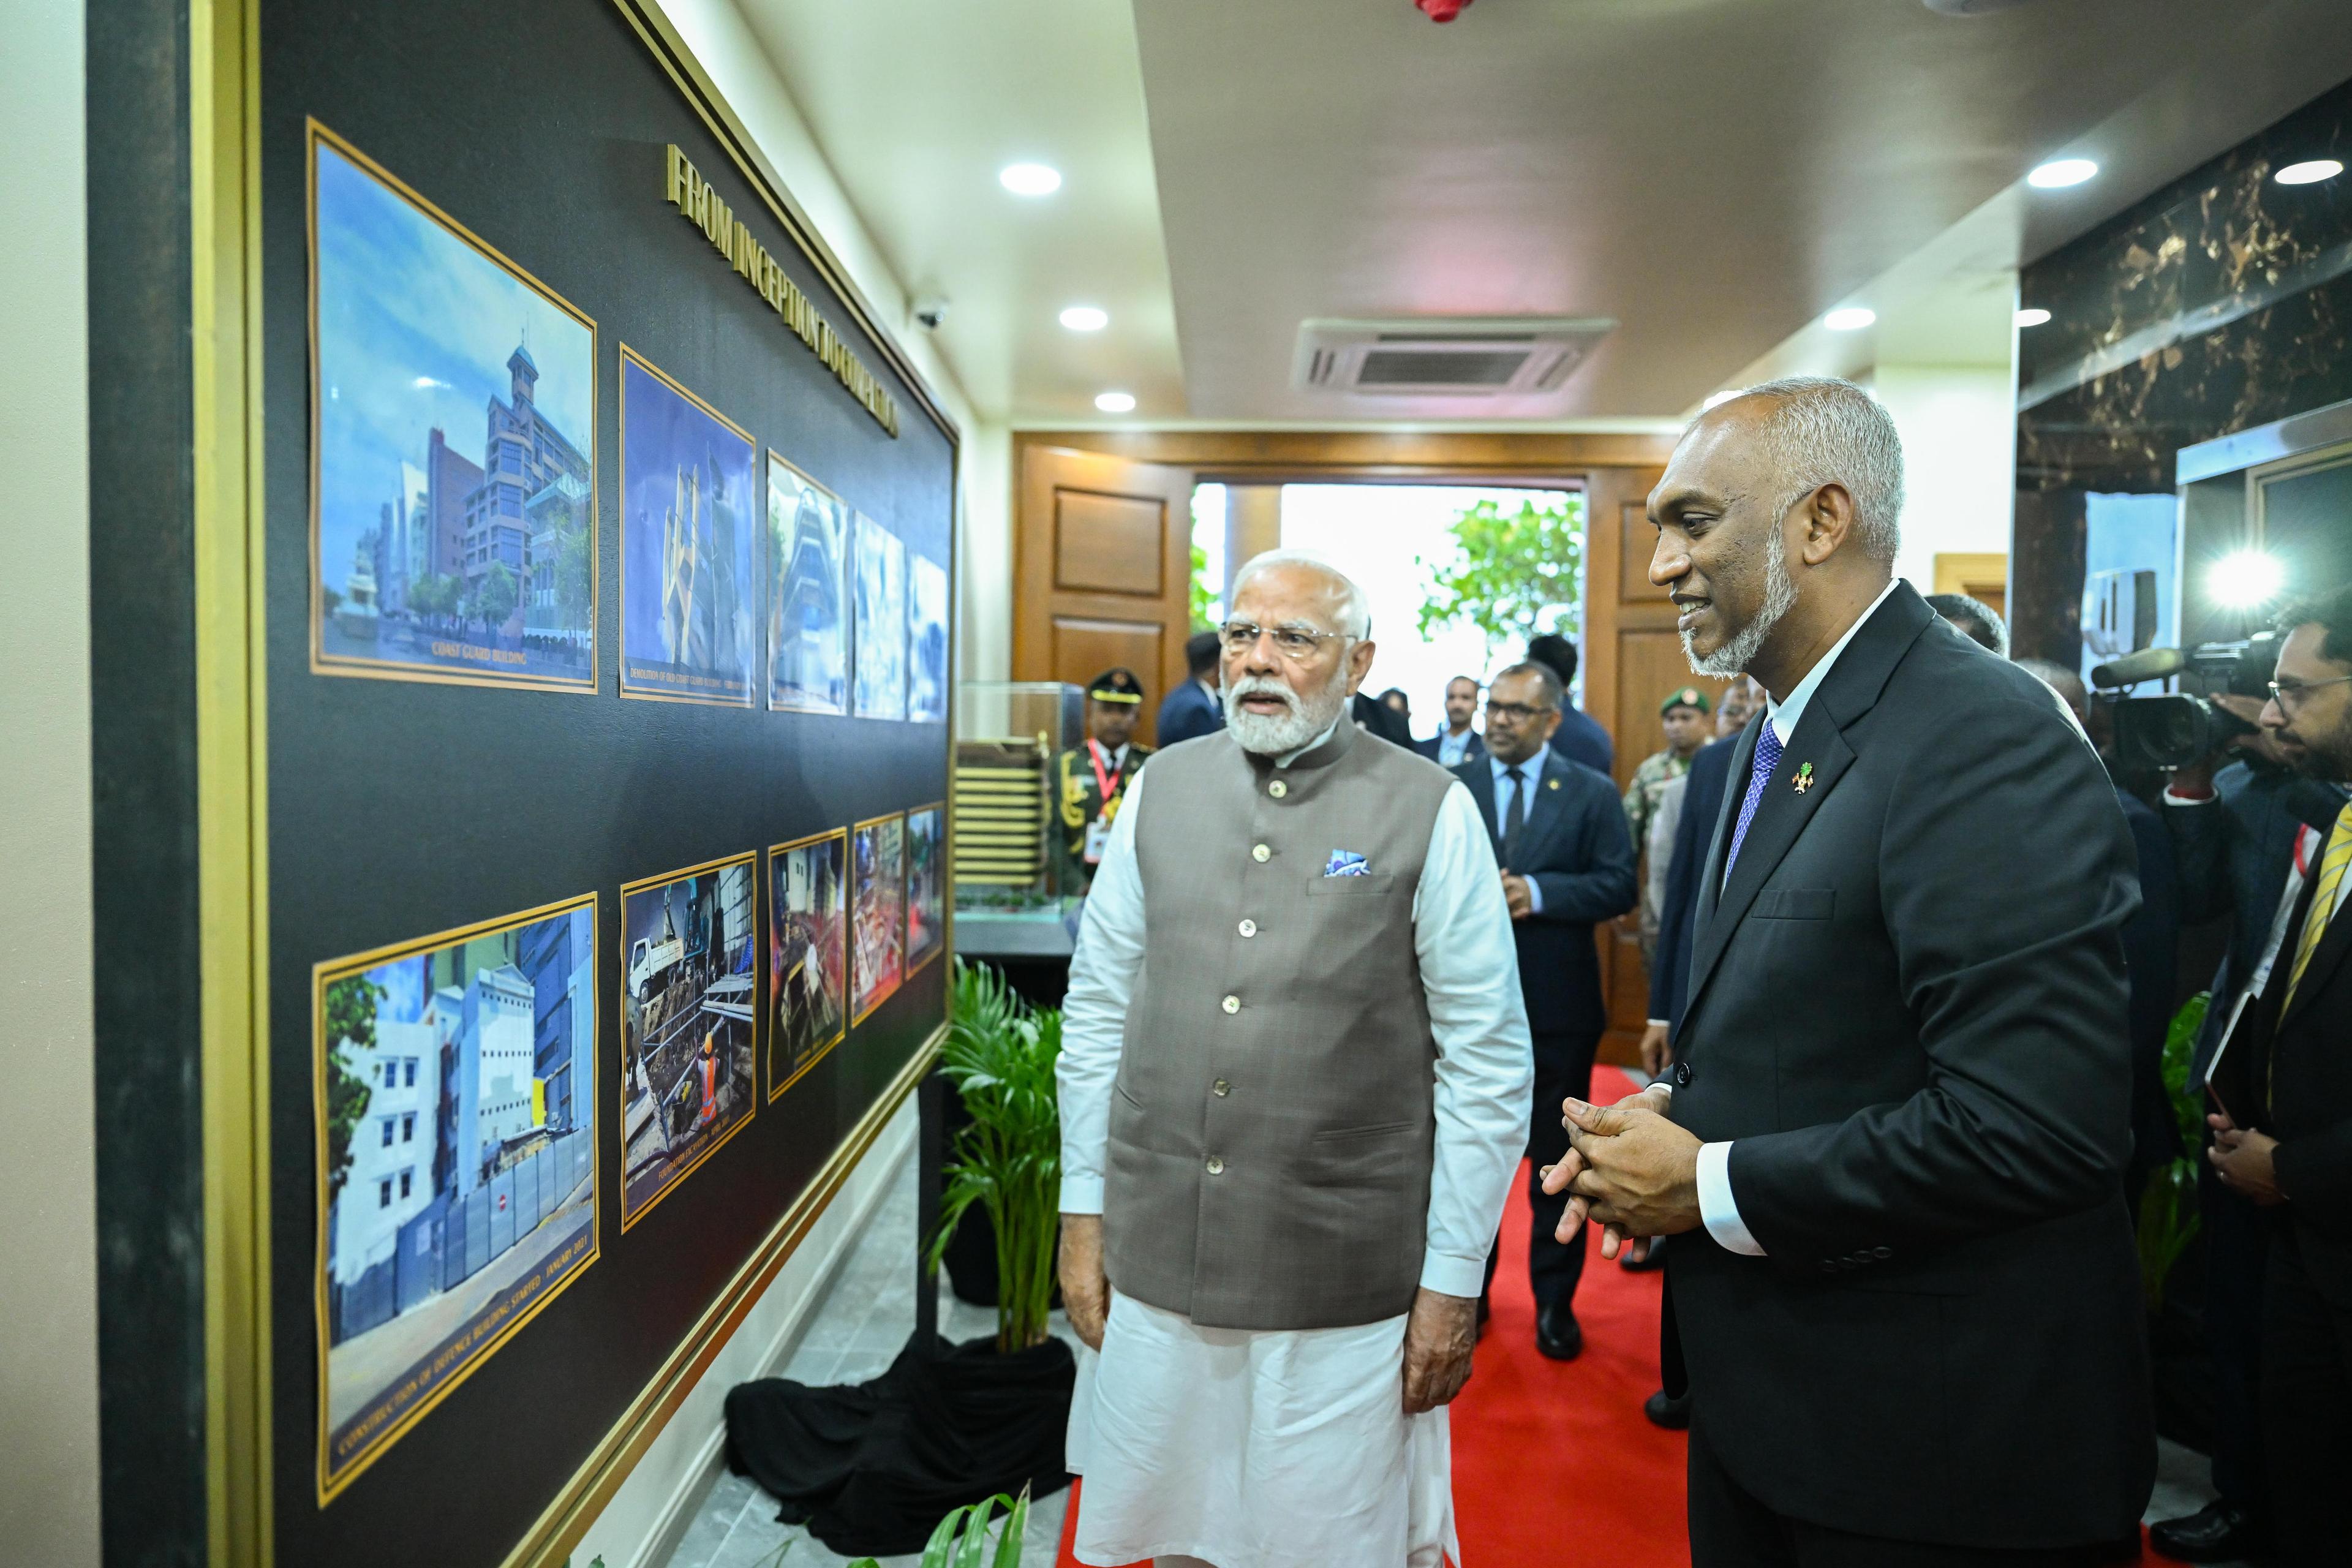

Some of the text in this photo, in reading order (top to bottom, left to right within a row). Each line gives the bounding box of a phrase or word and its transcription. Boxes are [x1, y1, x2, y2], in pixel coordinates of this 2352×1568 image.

[668, 144, 733, 262] FROM
[733, 221, 820, 353] INCEPTION
[819, 318, 839, 372] TO
[432, 642, 527, 665] COAST GUARD BUILDING
[630, 668, 658, 680] DEMOLITION
[659, 672, 666, 681] OF
[658, 1152, 685, 1182] FOUNDATION
[511, 1275, 541, 1308] STARTED
[546, 1248, 572, 1278] JANUARY
[573, 1234, 587, 1254] 2021
